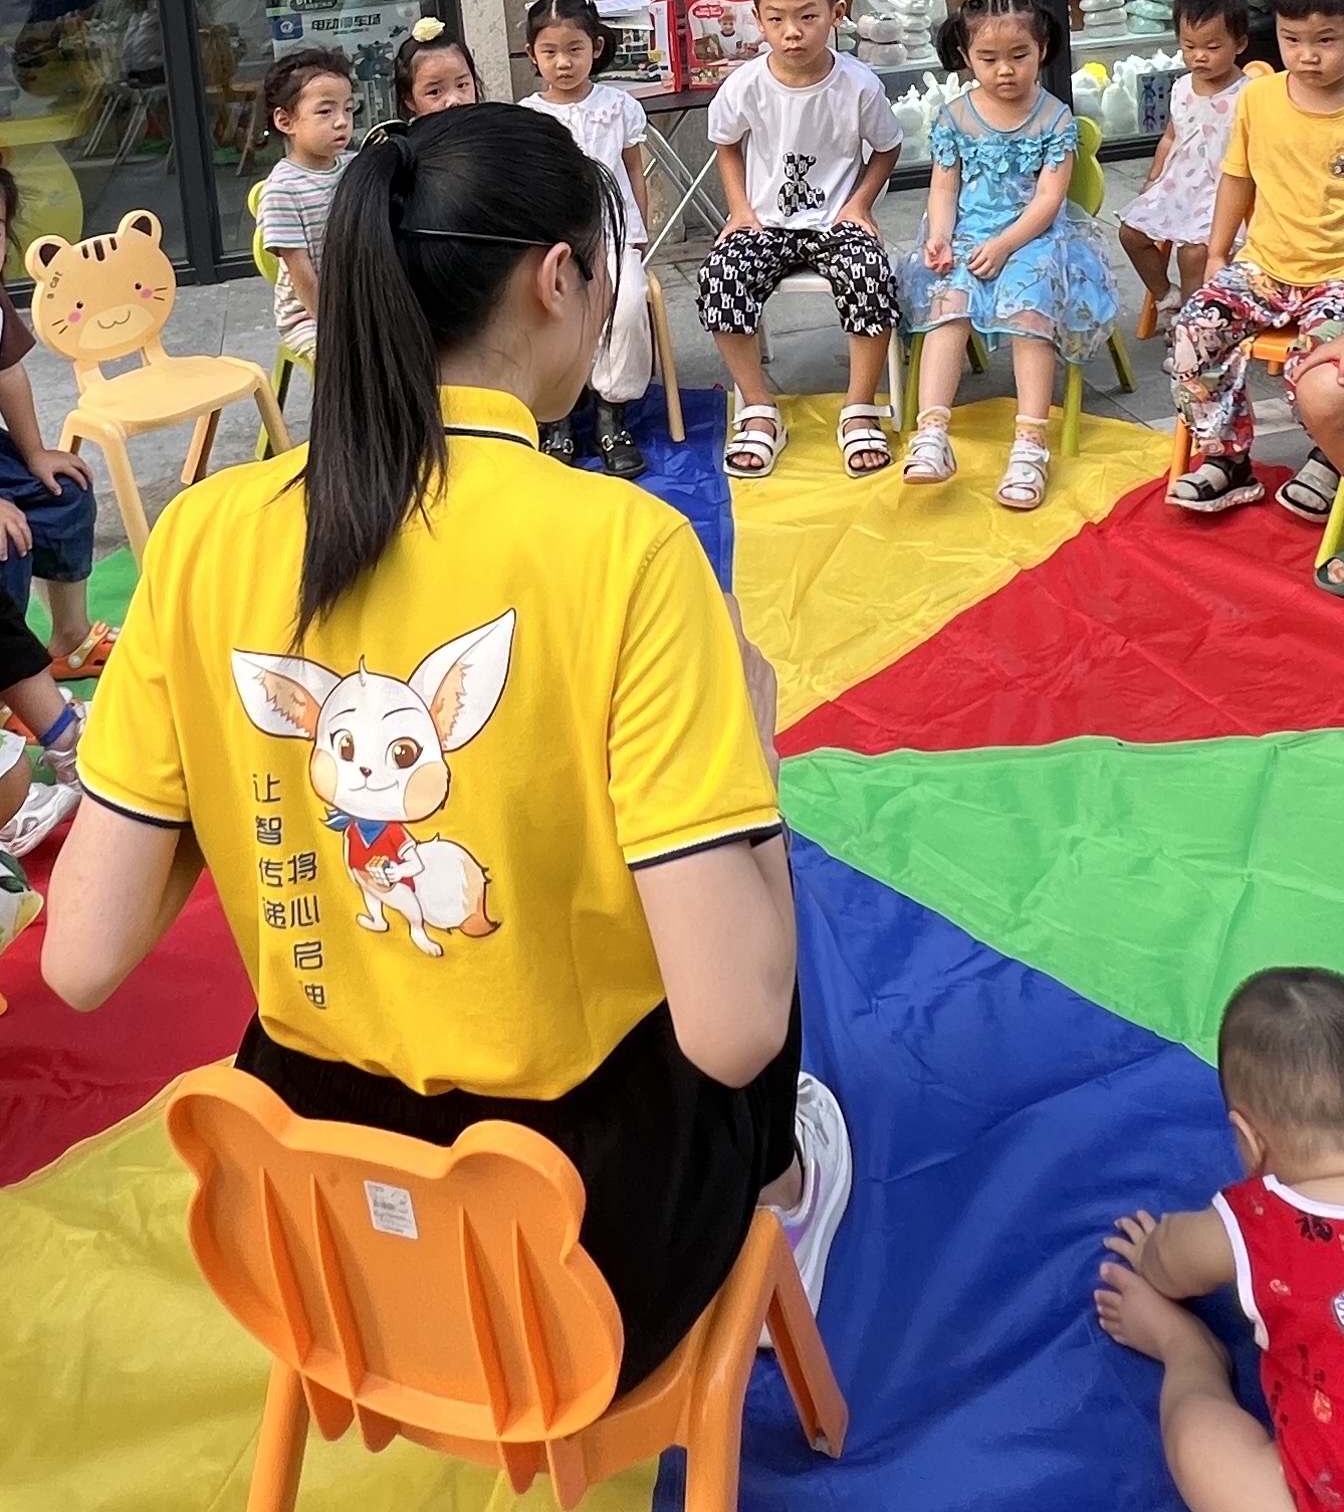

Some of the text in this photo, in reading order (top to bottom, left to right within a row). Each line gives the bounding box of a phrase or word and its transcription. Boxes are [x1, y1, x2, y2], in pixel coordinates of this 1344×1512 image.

[49, 271, 63, 289] cat
[252, 772, 287, 930] 让智传递
[286, 851, 328, 1010] 将心启迪
